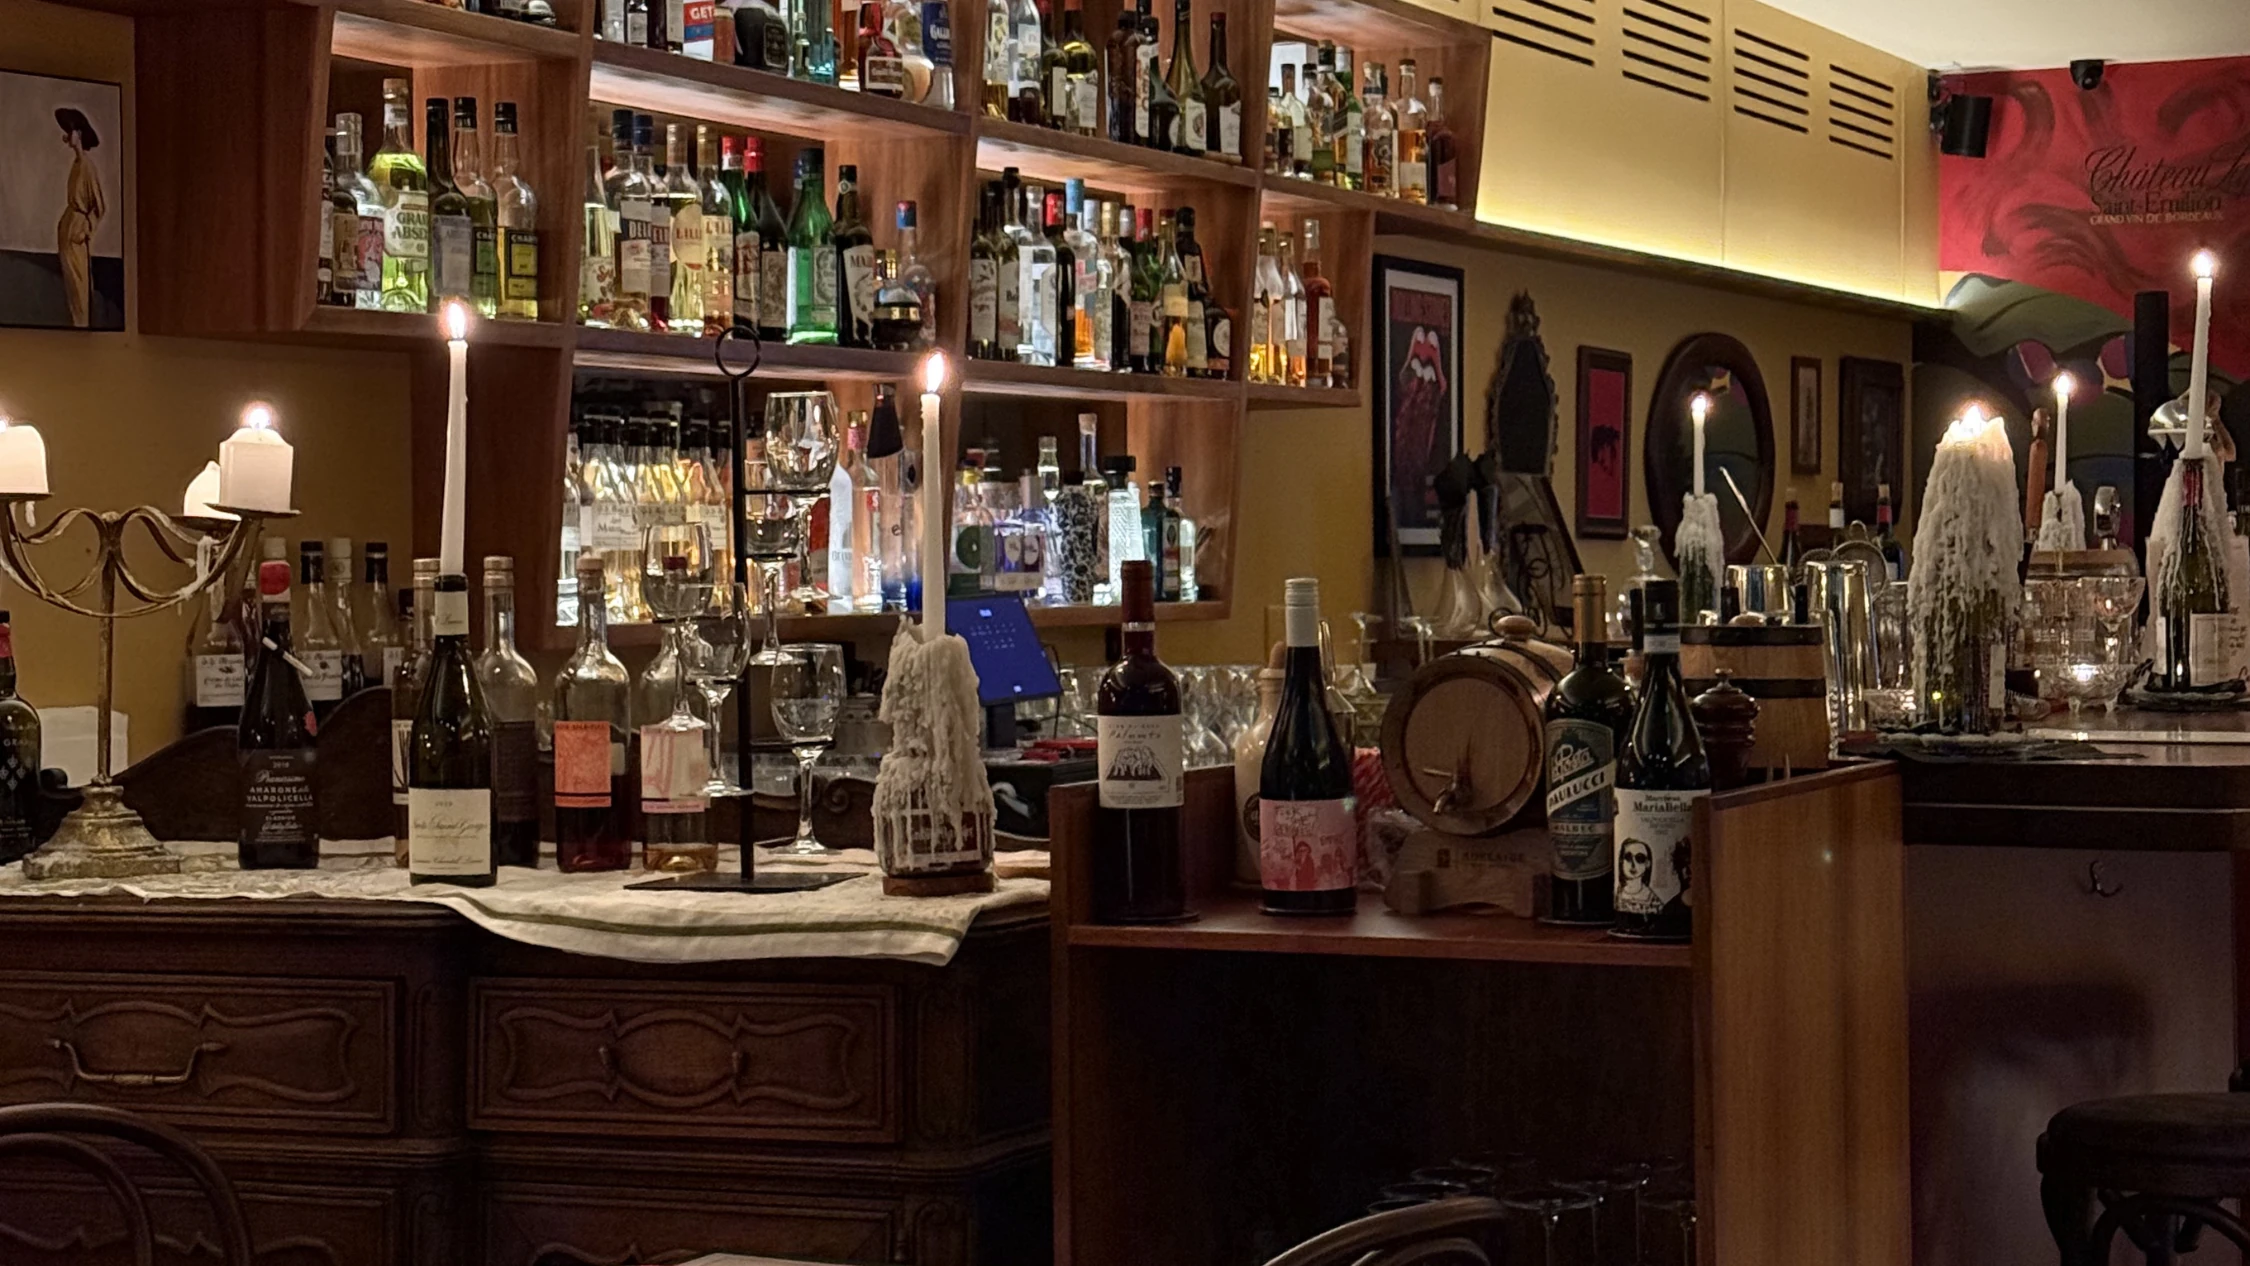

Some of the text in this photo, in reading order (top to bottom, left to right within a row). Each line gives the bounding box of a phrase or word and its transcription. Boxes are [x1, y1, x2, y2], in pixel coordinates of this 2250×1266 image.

[2127, 213, 2144, 224] VIN
[2146, 213, 2161, 224] DE
[1548, 771, 1606, 811] PAULUCCI
[246, 793, 314, 803] VALPOLICELLA
